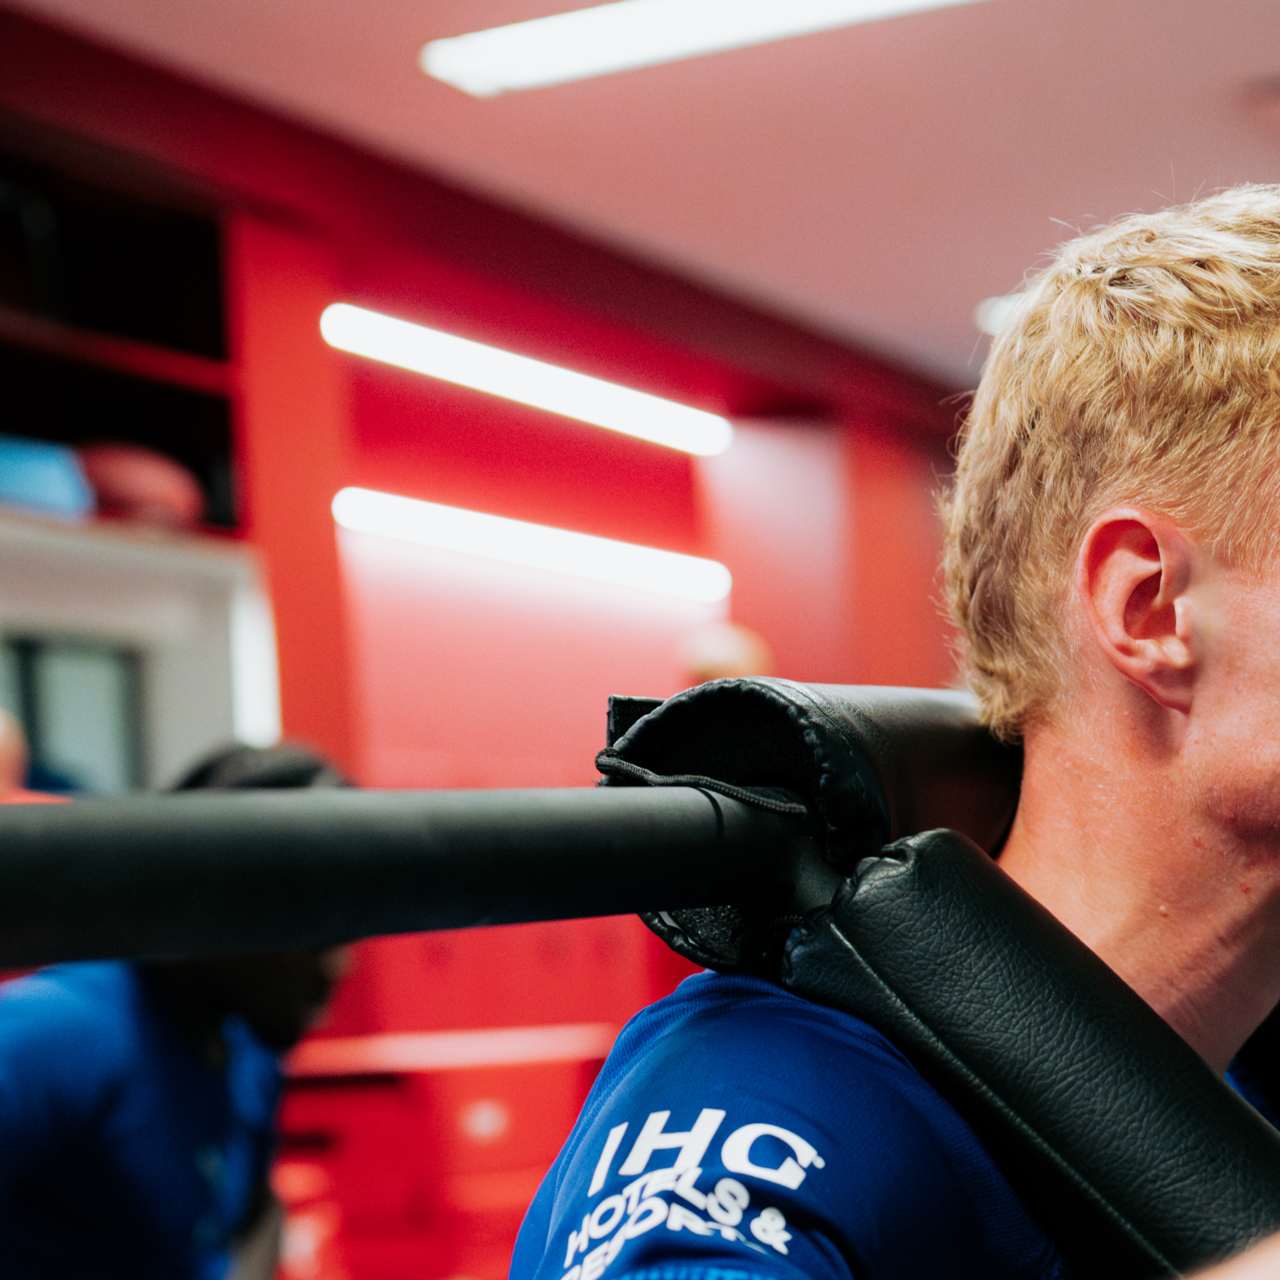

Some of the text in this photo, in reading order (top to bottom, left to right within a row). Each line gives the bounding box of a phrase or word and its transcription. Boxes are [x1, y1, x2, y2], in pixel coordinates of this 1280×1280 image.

[588, 1108, 818, 1197] IHG
[563, 1167, 792, 1268] HOTELS &
